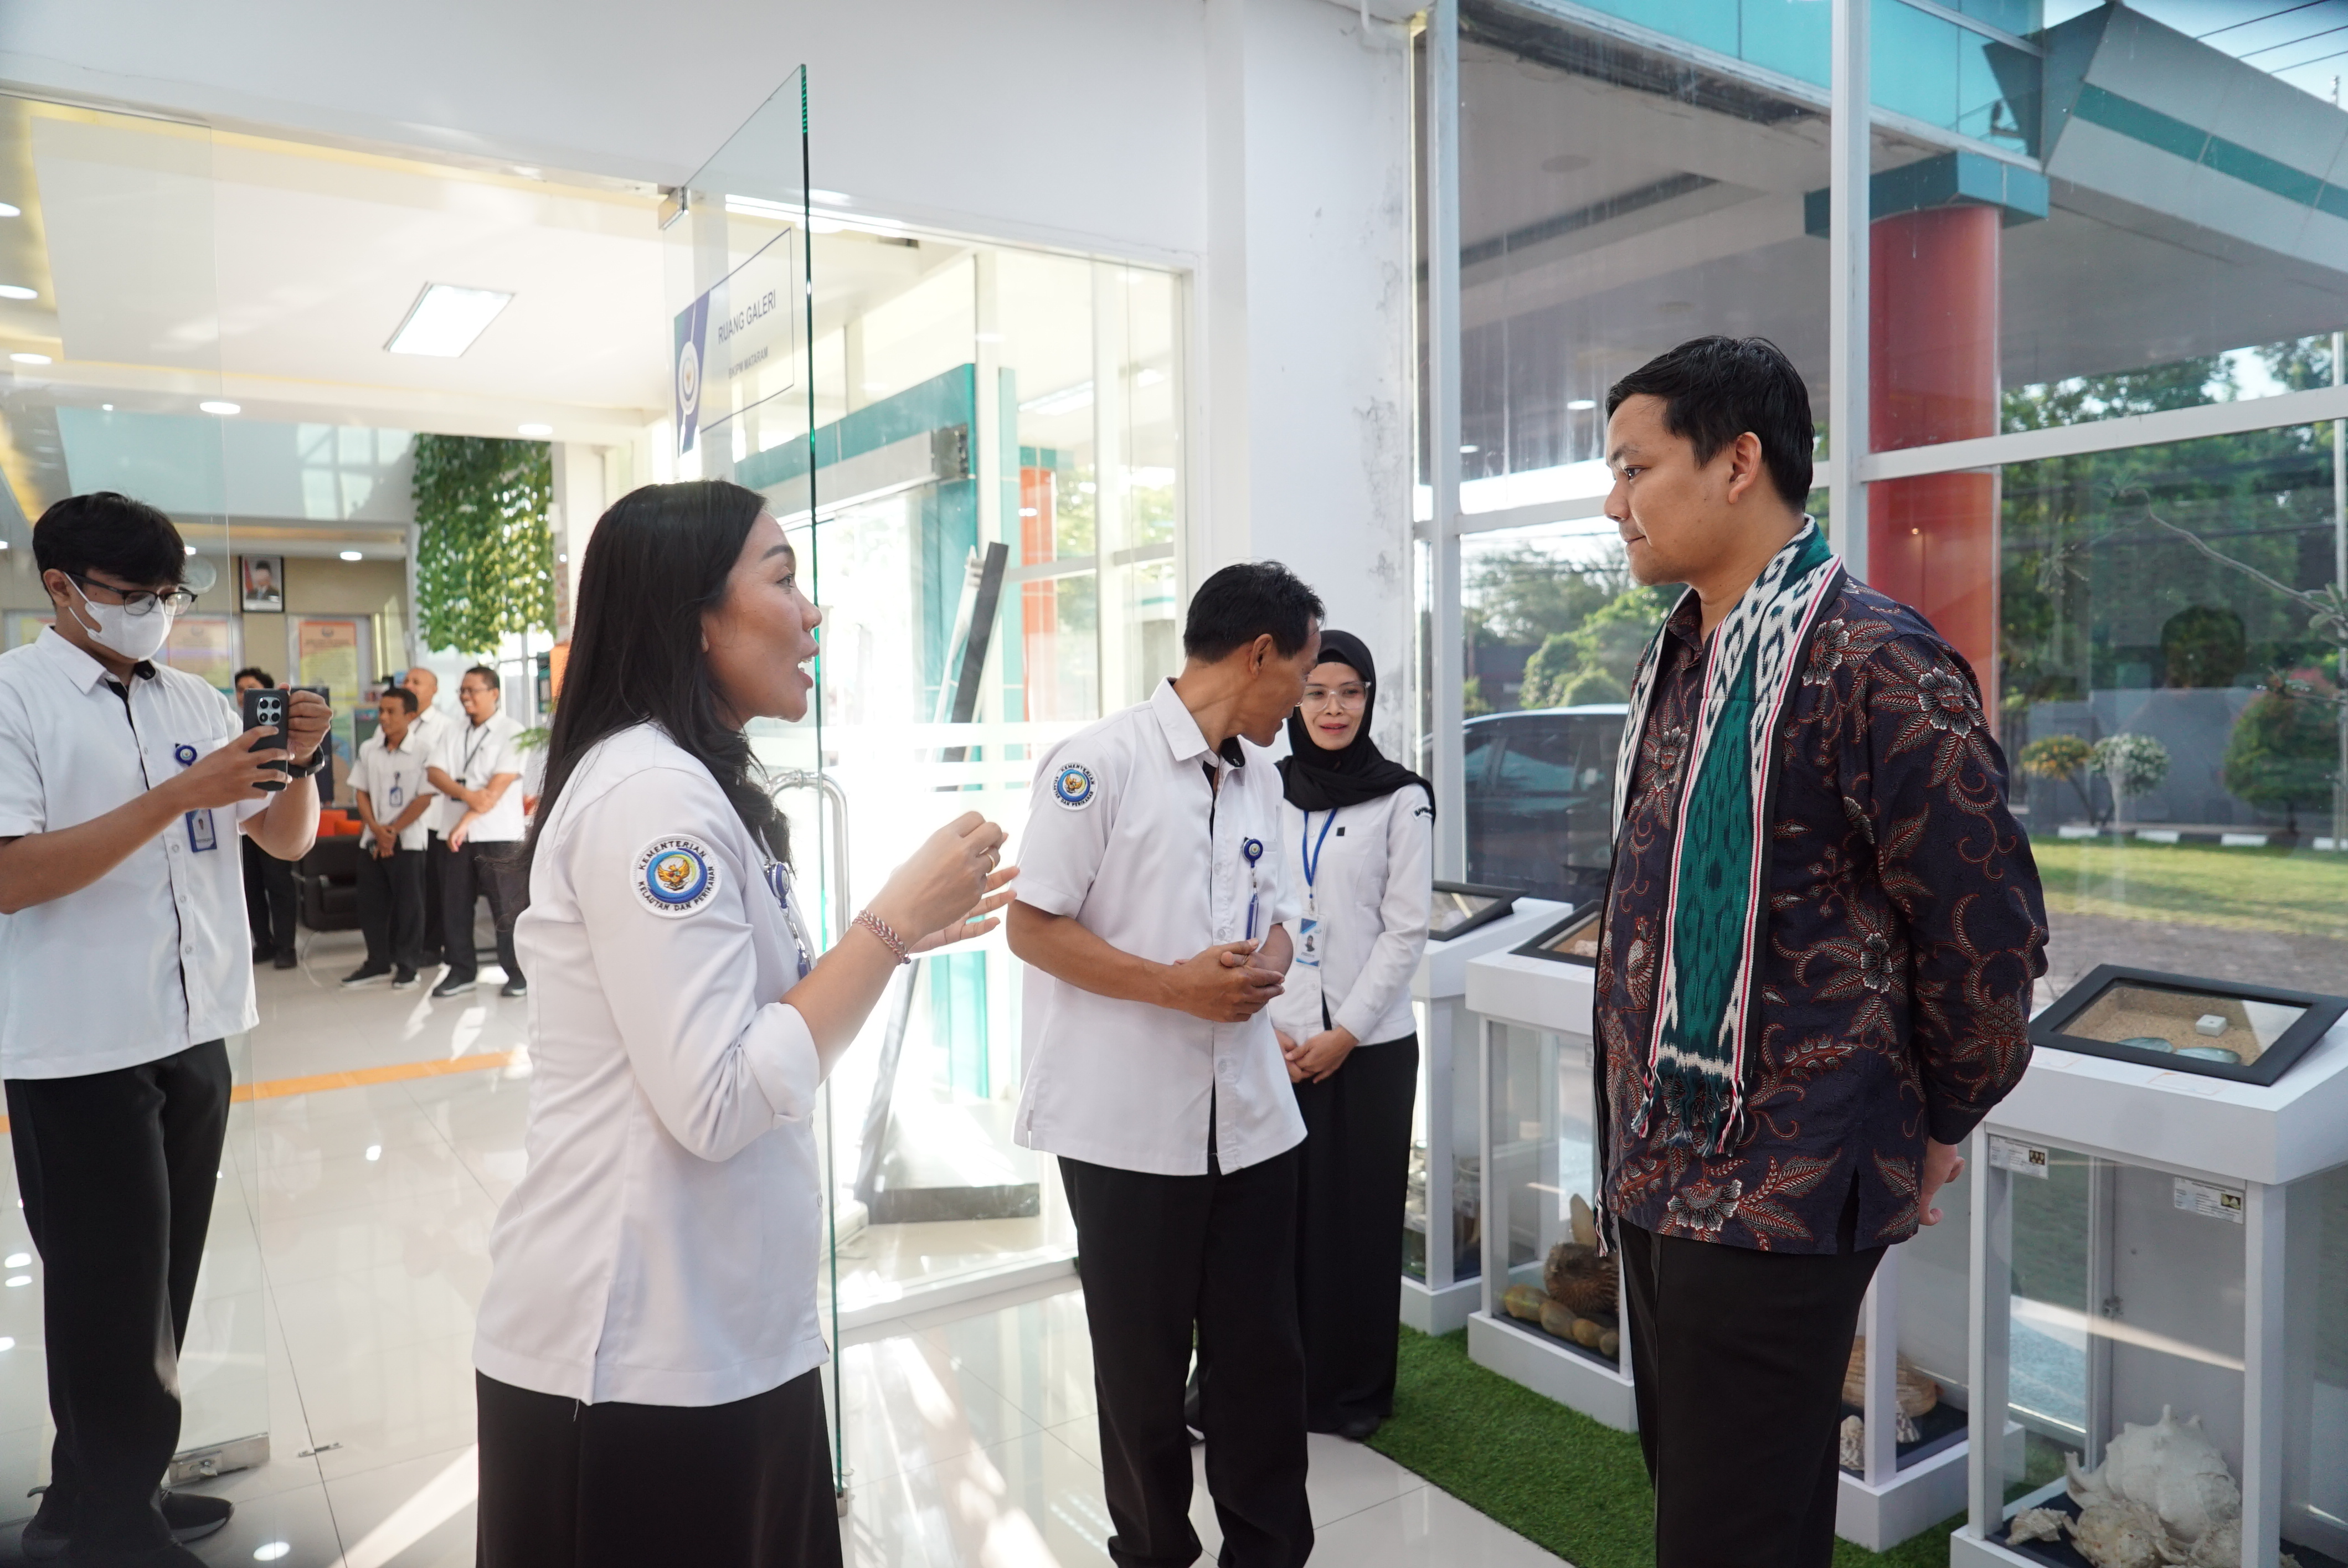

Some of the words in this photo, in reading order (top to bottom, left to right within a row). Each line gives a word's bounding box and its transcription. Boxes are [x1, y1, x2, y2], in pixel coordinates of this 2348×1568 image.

[718, 311, 745, 344] RUANG
[746, 288, 776, 325] GALERI
[744, 345, 769, 370] MATARAM
[1060, 764, 1095, 785] KEMENTERIAN
[1072, 791, 1094, 807] PERIKANAN
[639, 840, 707, 870] KEMENTERIAN
[638, 881, 670, 911] KELAUTAN
[674, 902, 692, 911] DAN
[694, 866, 715, 905] PERIKANAN
